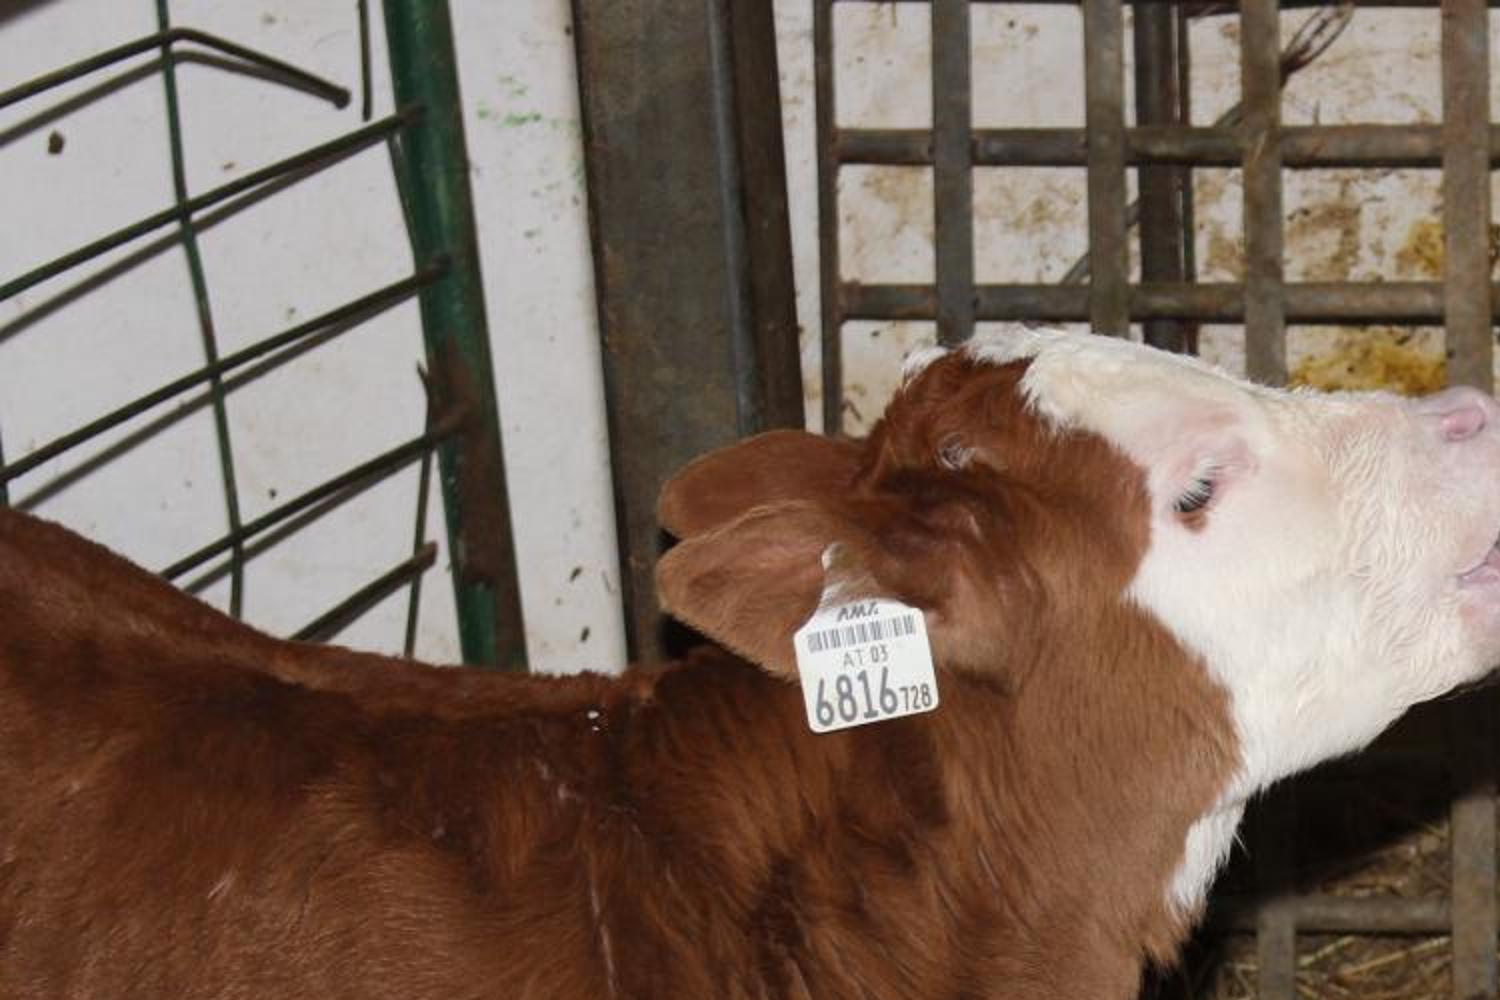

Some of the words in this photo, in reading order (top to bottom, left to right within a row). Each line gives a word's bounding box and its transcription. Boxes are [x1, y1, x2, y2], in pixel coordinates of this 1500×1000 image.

[842, 647, 865, 668] AT
[870, 643, 889, 663] 03
[815, 666, 898, 727] 6816
[899, 683, 933, 712] 728
